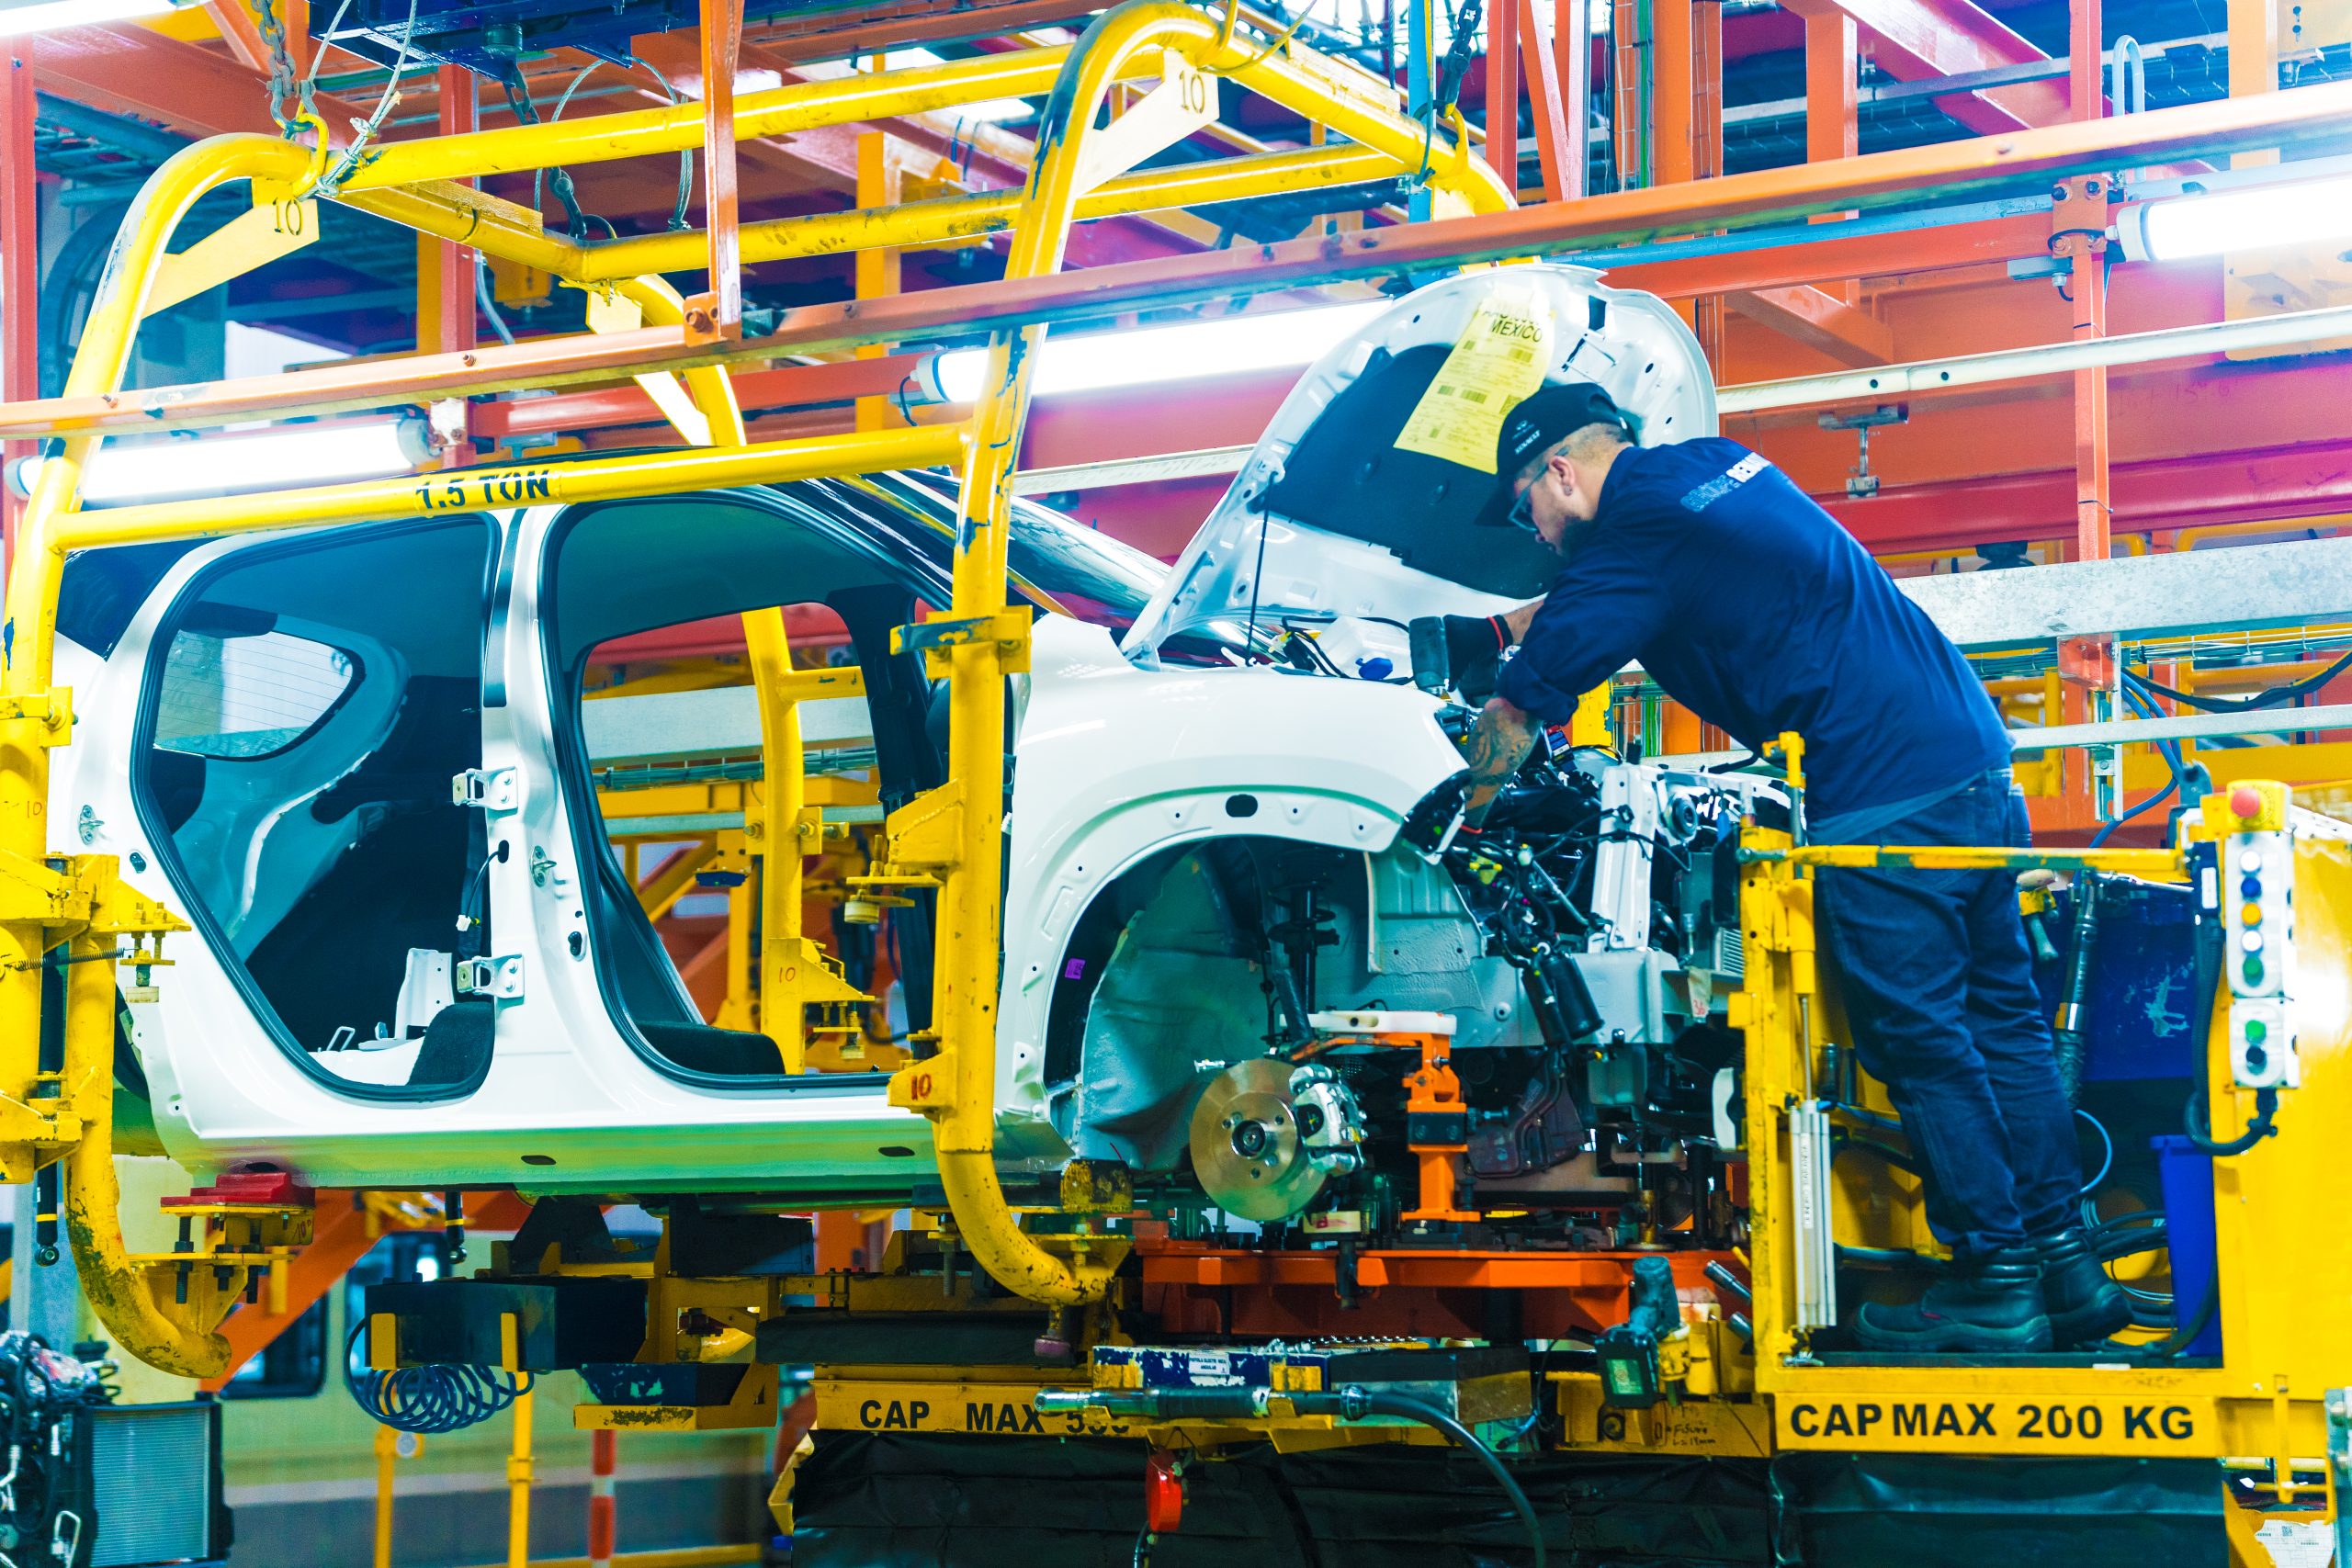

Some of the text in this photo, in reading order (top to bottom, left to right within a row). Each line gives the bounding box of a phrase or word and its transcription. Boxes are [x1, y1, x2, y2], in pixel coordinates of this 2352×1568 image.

[1179, 70, 1205, 114] 10
[271, 197, 302, 236] 10
[1491, 319, 1544, 343] MEXICO
[415, 469, 550, 510] 1.5 TON
[27, 800, 43, 818] 10
[779, 966, 796, 984] 10
[910, 1072, 933, 1101] 10
[859, 1399, 930, 1429] CAP
[967, 1402, 1046, 1433] MAX
[1790, 1403, 2194, 1439] CAP MAX 200 KG
